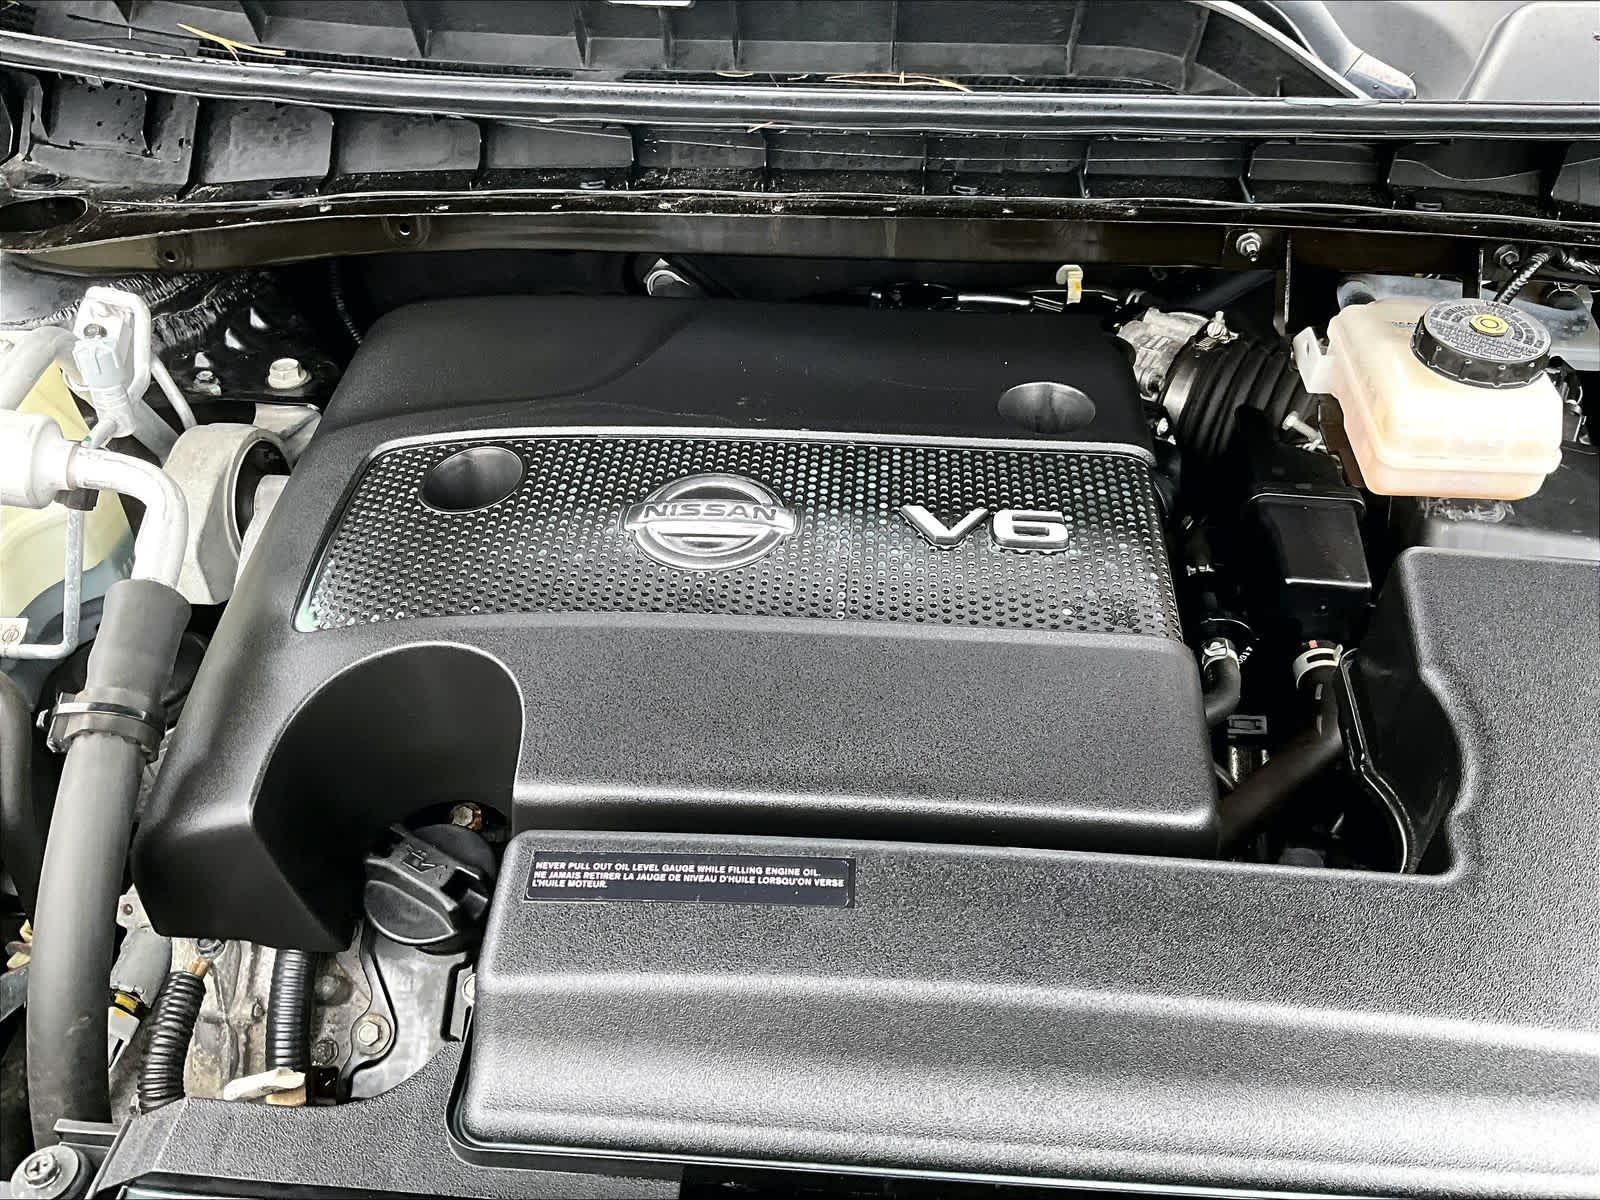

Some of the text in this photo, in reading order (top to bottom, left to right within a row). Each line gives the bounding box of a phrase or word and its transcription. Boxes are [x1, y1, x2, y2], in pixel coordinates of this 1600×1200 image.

[643, 502, 777, 521] NISSAN
[900, 504, 1069, 550] V6
[535, 861, 821, 877] NEVER PULL OUT OIL LEVEL GAUGE WHILE FILLING ENGINE OIL.
[531, 879, 608, 888] L'HUILE MOTEUR.
[533, 871, 845, 888] NE JAMAIS RETIRER LA JAUGE DE NIVEAU D'HUILE LORSQU'ON VERSE
